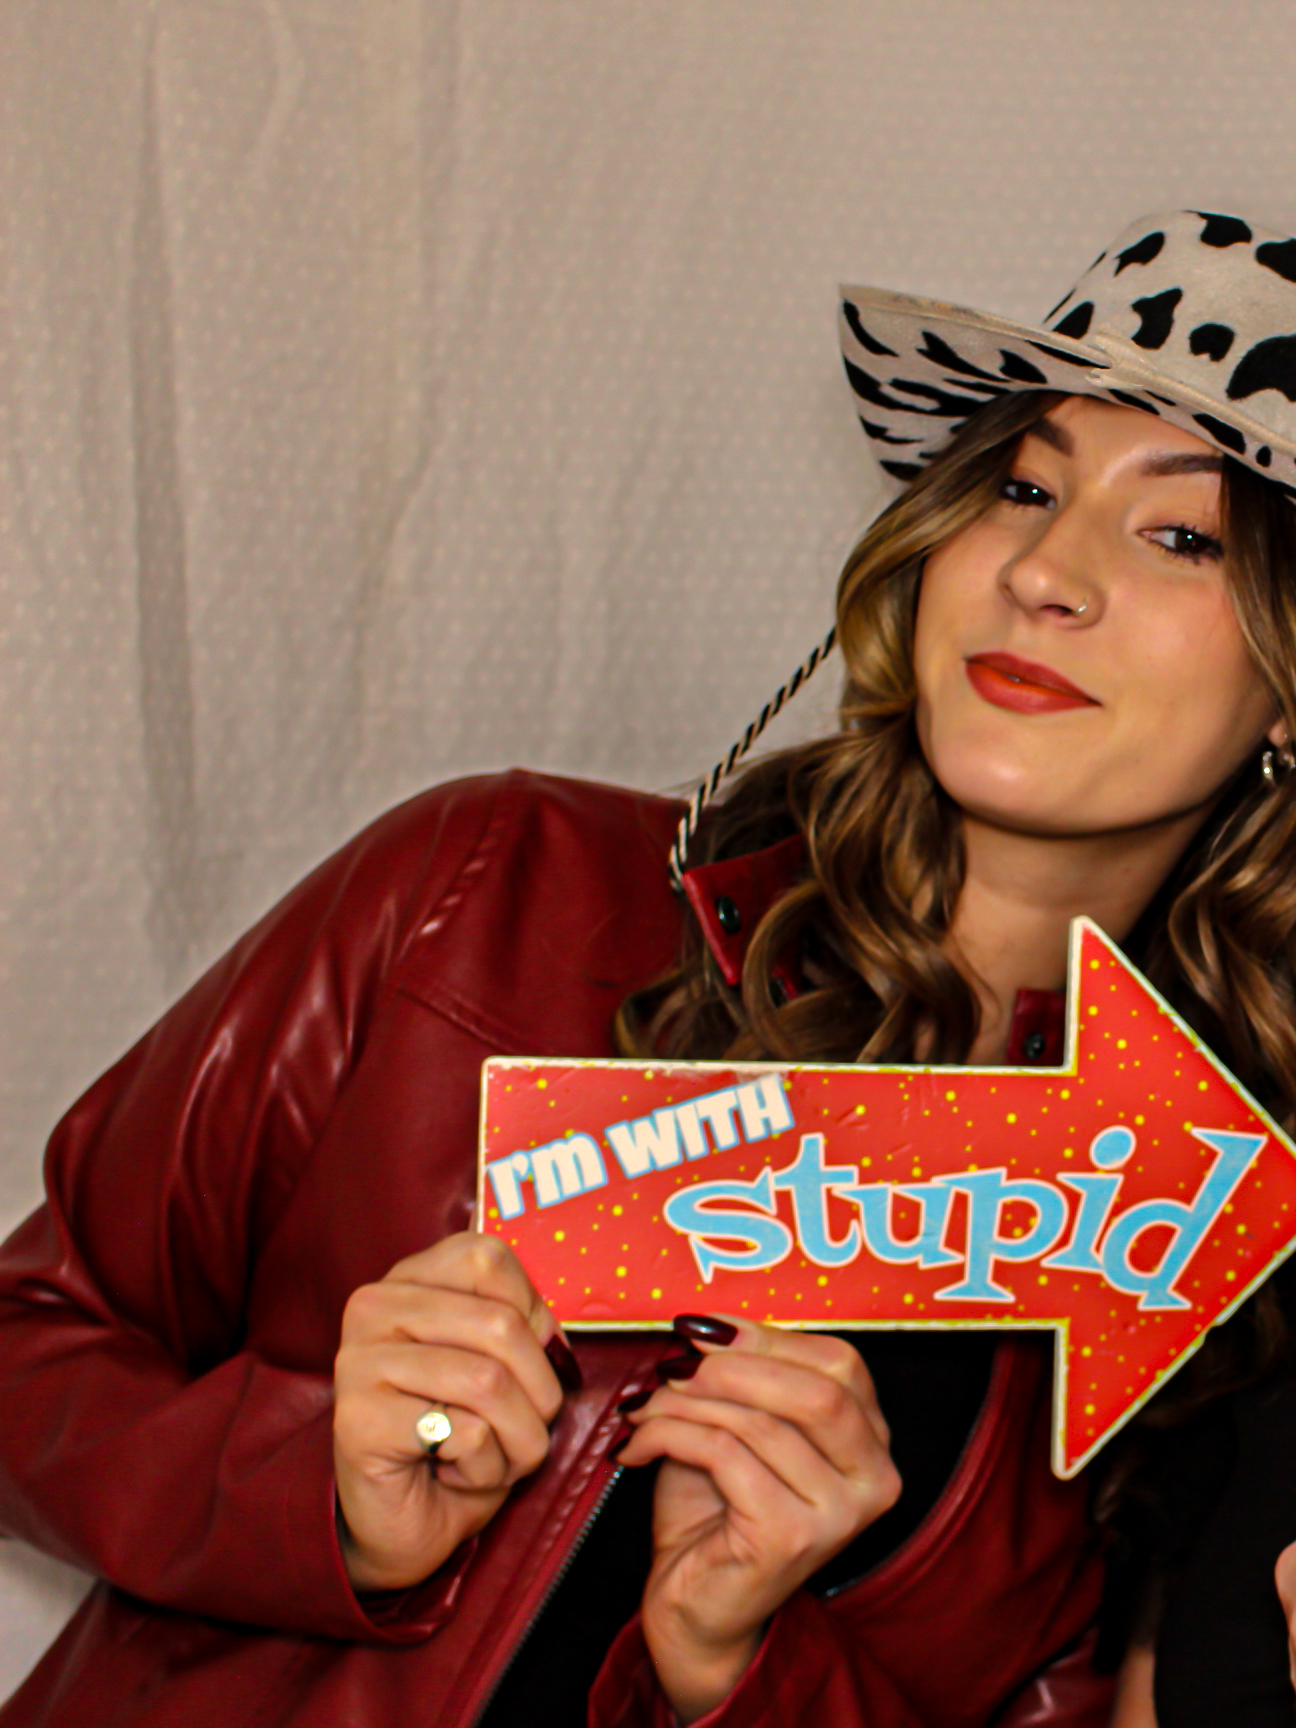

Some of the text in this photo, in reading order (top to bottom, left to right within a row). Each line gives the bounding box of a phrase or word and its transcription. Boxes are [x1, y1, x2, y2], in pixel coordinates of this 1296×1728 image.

[488, 1073, 795, 1220] I'm WITH
[663, 1125, 1266, 1311] stupid
